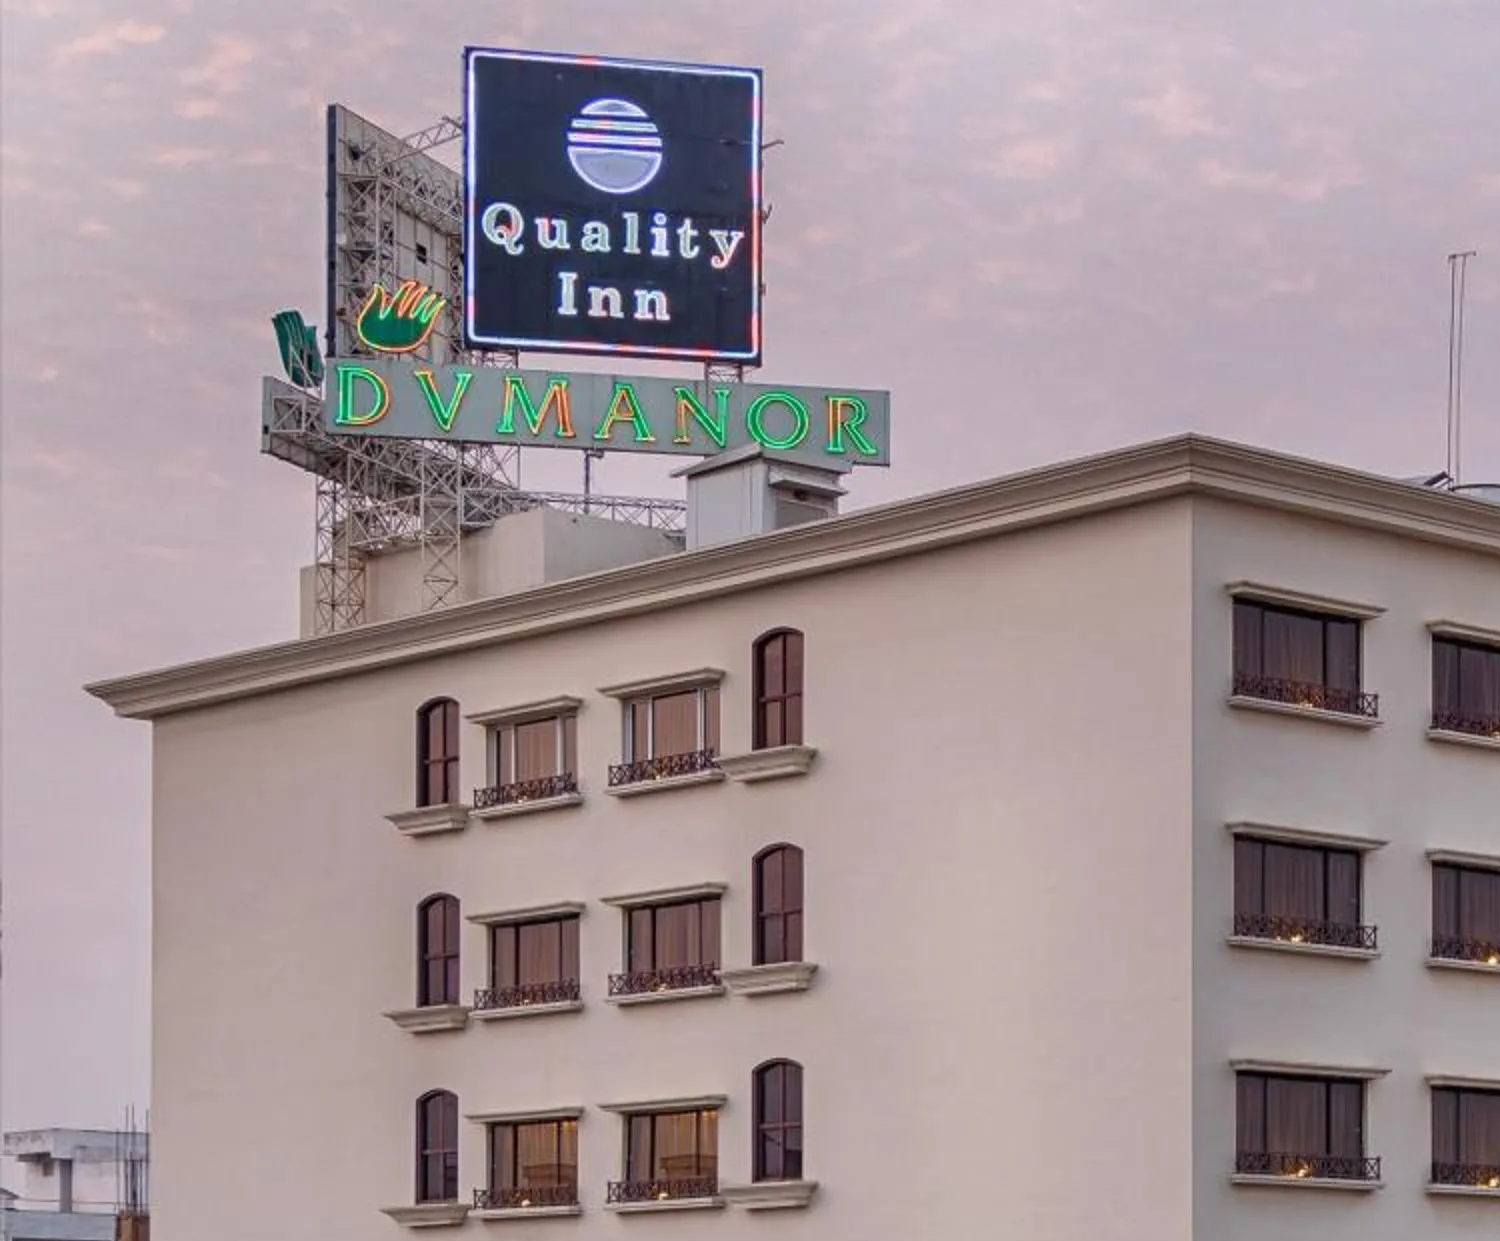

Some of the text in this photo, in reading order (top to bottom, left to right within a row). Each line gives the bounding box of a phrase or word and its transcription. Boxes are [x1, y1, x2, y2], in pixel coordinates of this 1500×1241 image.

[481, 202, 745, 270] Quality
[557, 271, 672, 322] Inn
[496, 376, 878, 456] MANOR
